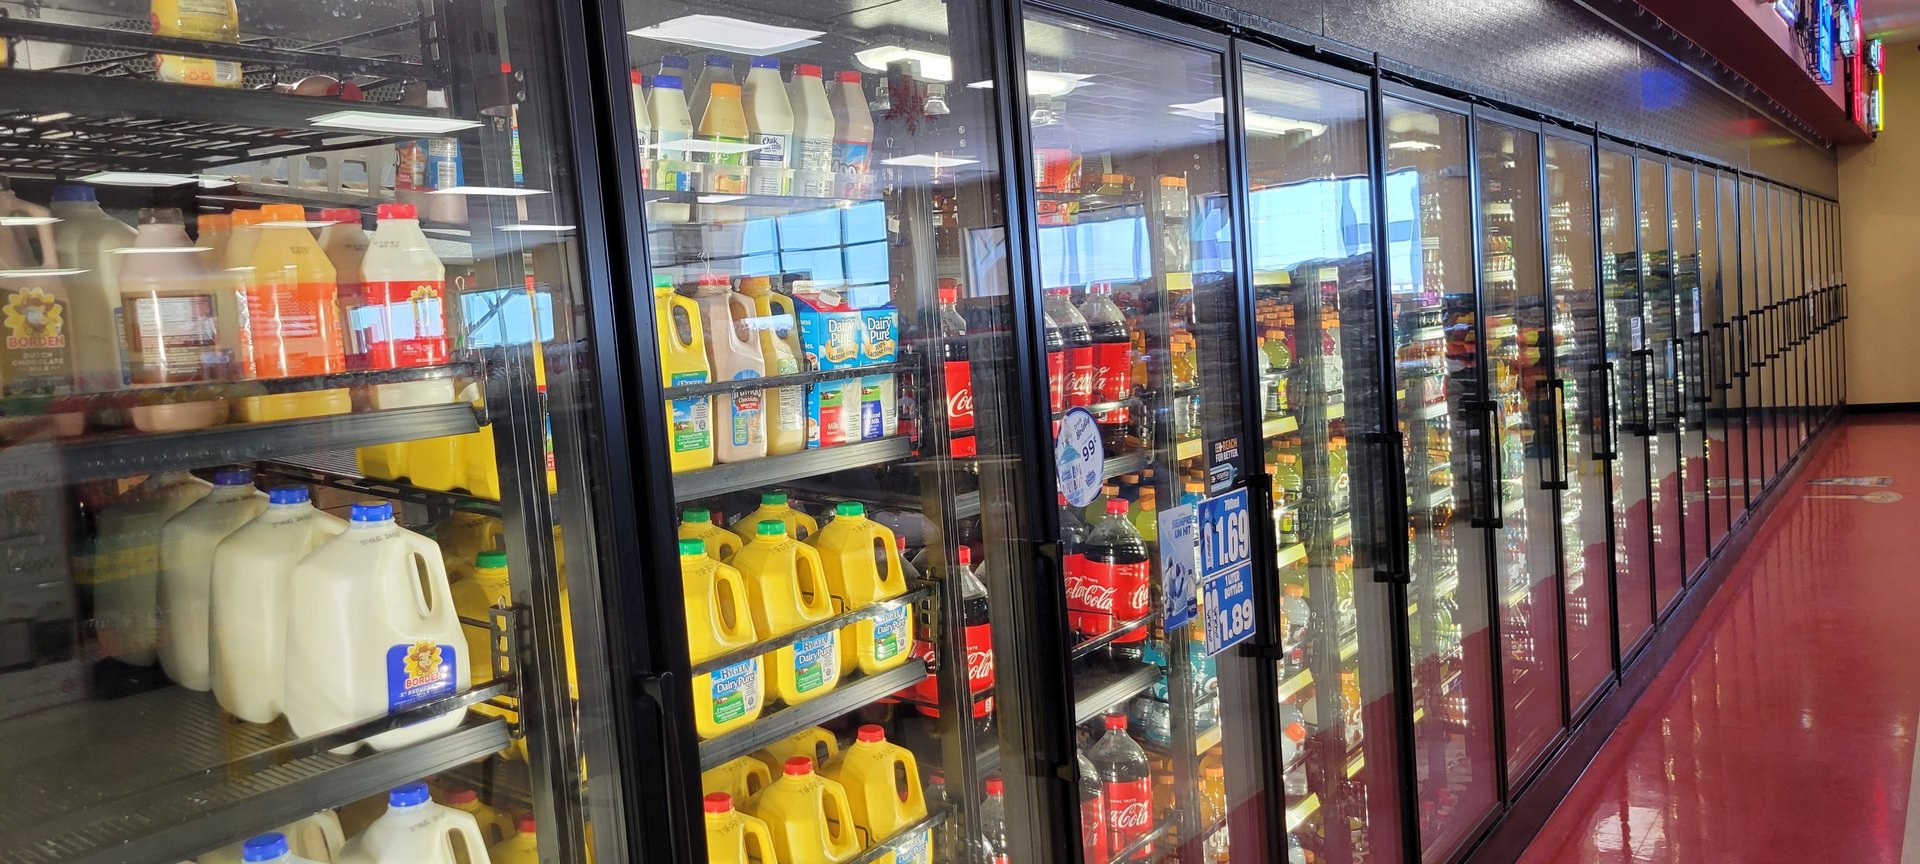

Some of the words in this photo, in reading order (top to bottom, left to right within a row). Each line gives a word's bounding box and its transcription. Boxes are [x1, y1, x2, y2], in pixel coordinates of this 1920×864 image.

[762, 136, 779, 146] Oak
[827, 318, 855, 333] Dairy
[867, 317, 892, 331] Dairy
[7, 335, 65, 349] BORDEN
[831, 332, 852, 347] Pure
[870, 330, 890, 344] Pure
[11, 358, 64, 367] CHOCOLATE
[1222, 437, 1238, 450] REACH
[1215, 452, 1224, 463] FOR
[1171, 514, 1193, 529] SIEMPRE
[1174, 527, 1182, 539] UN
[1182, 525, 1192, 537] HIT
[1220, 599, 1253, 642] 1.89
[798, 651, 819, 664] Dairy
[720, 663, 750, 679] HYGEIA
[716, 680, 739, 694] Dairy
[736, 672, 755, 686] Pure
